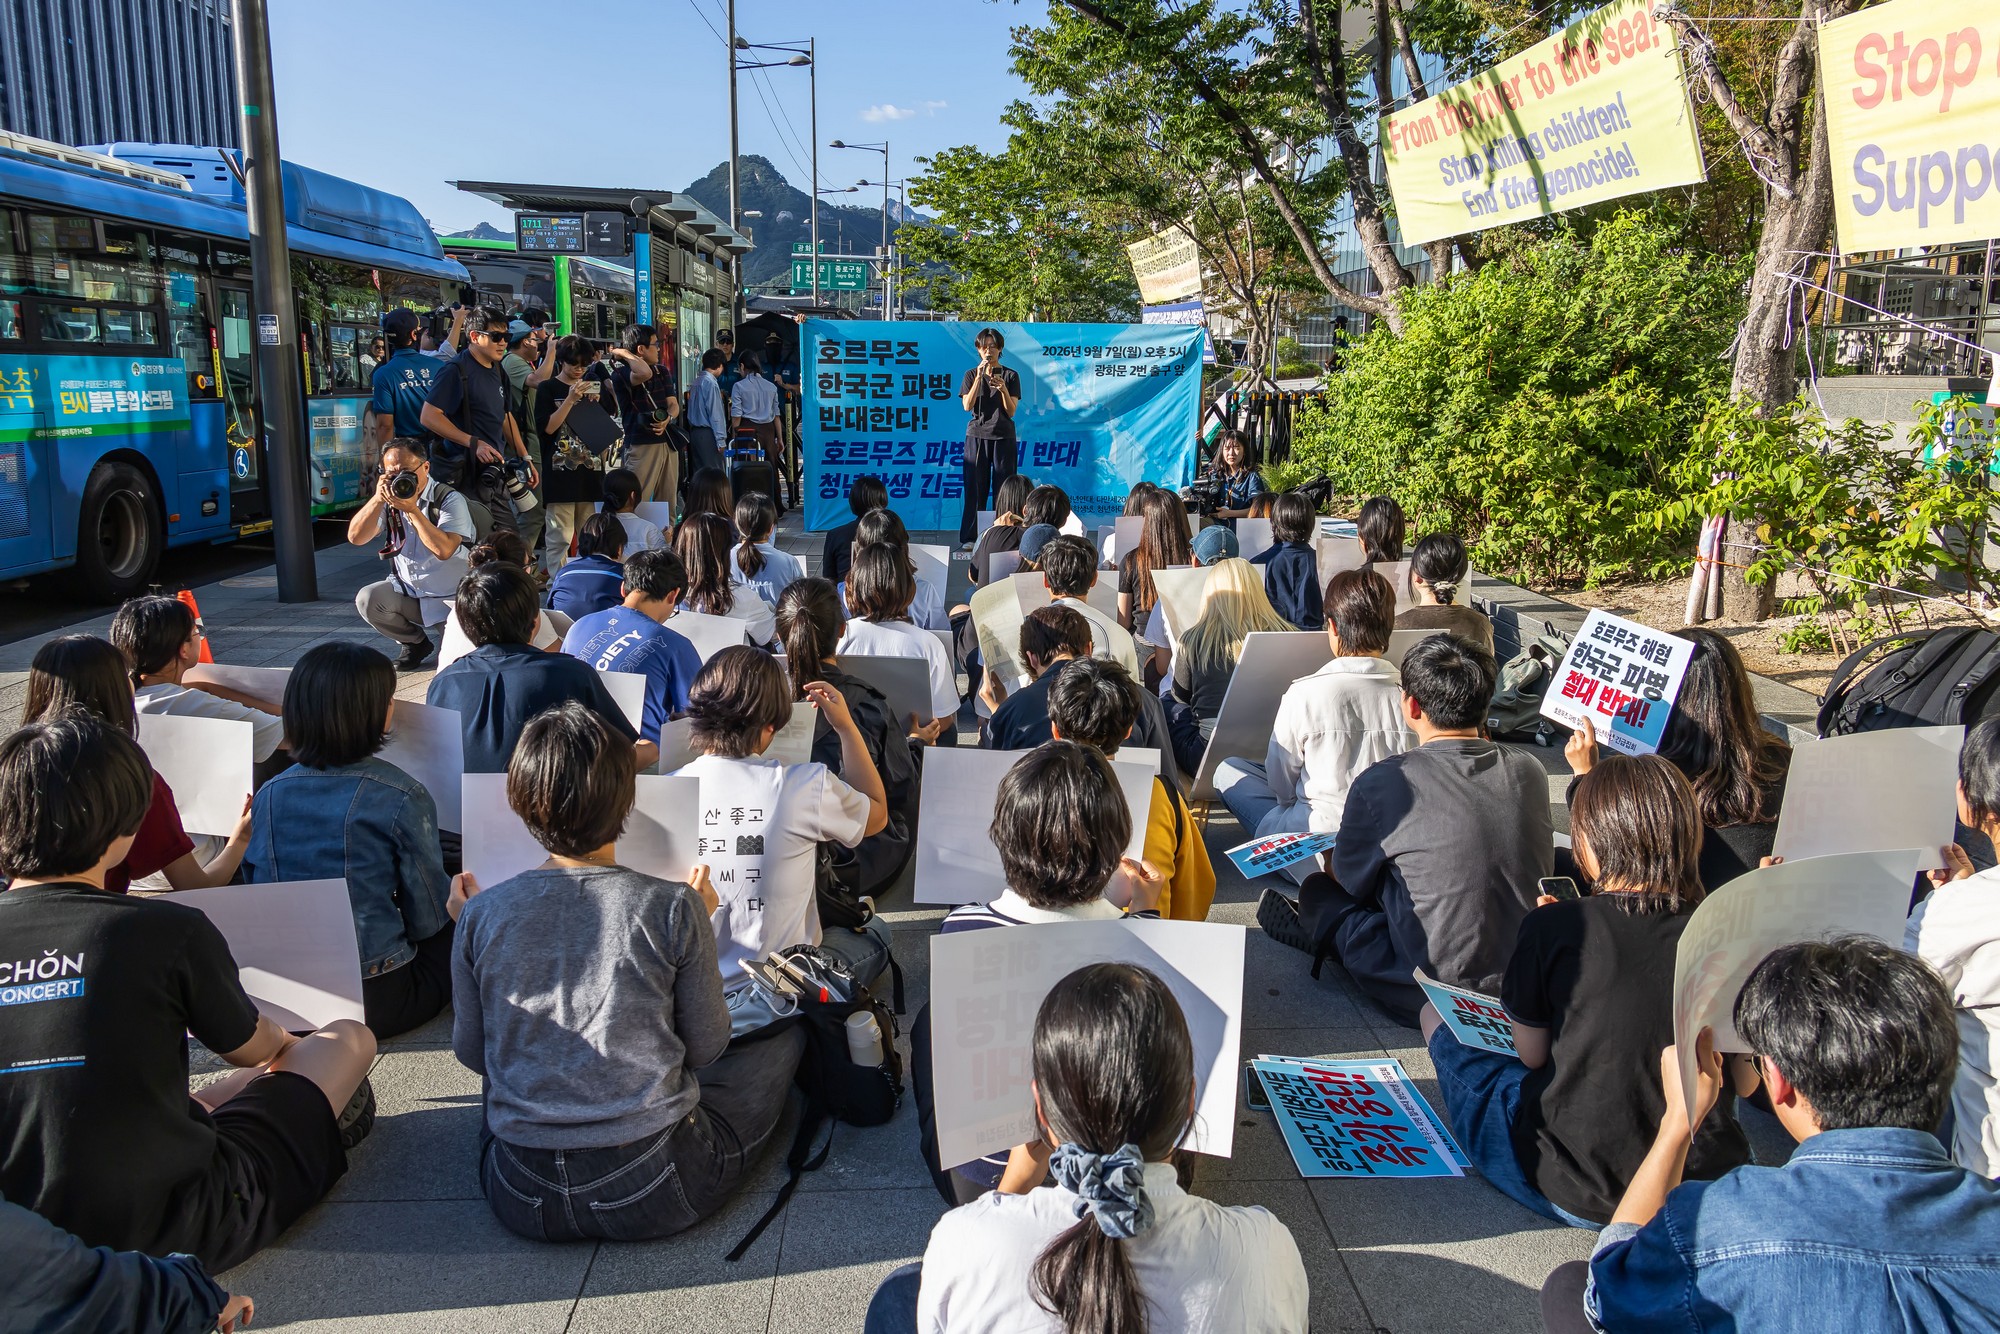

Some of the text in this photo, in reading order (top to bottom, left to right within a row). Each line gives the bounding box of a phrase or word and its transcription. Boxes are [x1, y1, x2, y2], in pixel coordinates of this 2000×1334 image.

[1389, 0, 1660, 155] From the river to the sea!
[1852, 27, 1982, 113] Stop
[1440, 91, 1632, 187] Stop killing children!
[1462, 142, 1640, 218] End the genocide!
[1852, 143, 2000, 228] Supp
[522, 219, 542, 229] 1711
[806, 264, 825, 272] 광문
[835, 264, 862, 273] 종로구청
[818, 339, 920, 366] 호르무즈
[1042, 346, 1186, 358] 2026년 9월 7일(월) 오후 5시
[404, 368, 430, 378] 경찰
[1094, 364, 1186, 377] 광화문 2번 출구 앞
[400, 380, 434, 390] POLIC
[818, 372, 952, 400] 한국군 파병
[60, 390, 174, 414] 딘시 블루 톤업 선크림
[819, 406, 928, 432] 반대한다!
[821, 440, 917, 466] 호르무즈
[1033, 441, 1082, 468] 반대
[920, 473, 964, 498] 긴급
[1096, 496, 1128, 504] 다만세20
[596, 630, 642, 672] CIETY
[1590, 620, 1674, 667] 호르무즈 해협
[1570, 641, 1670, 702] 한국군 파병
[1561, 670, 1652, 728] 절대 반대!
[1615, 735, 1637, 751] 긴급집회
[705, 808, 763, 825] 산 좋고
[0, 980, 80, 1003] ONCERT
[1262, 1070, 1376, 1174] 호르무즈 파병검토
[1303, 1067, 1428, 1166] 즉각 중단!
